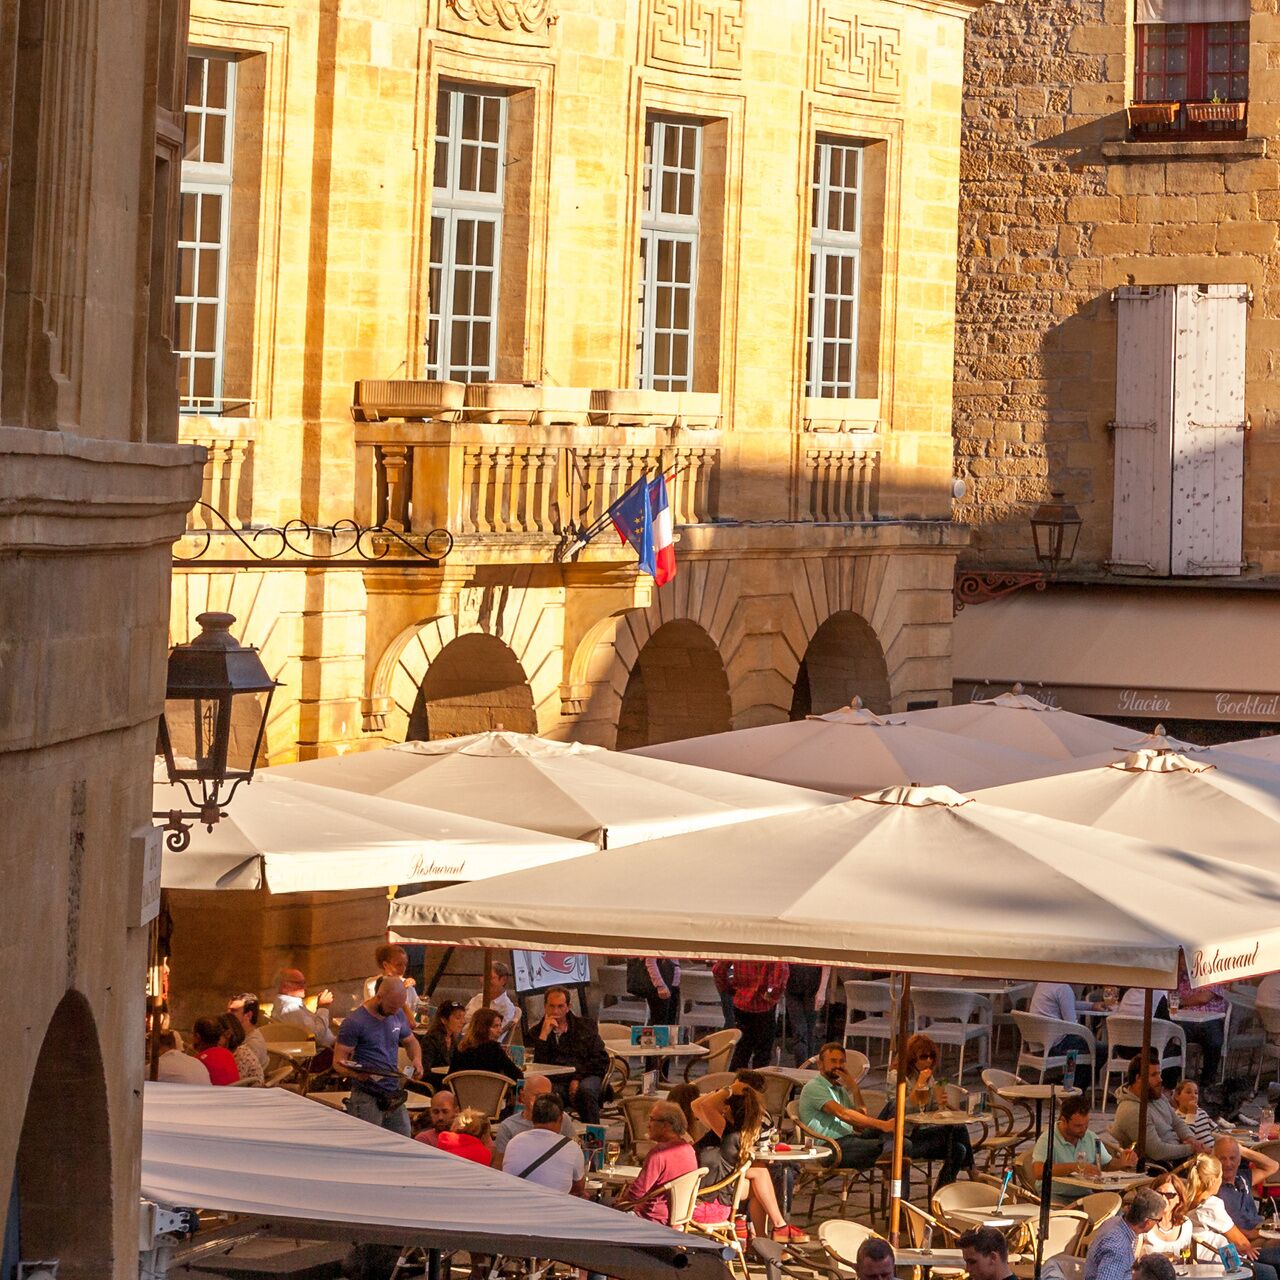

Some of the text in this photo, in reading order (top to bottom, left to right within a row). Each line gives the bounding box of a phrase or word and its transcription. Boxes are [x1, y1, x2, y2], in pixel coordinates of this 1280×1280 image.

[1117, 689, 1172, 712] Glacier
[1215, 692, 1280, 715] Cocktail
[406, 853, 466, 879] Restaurant
[1190, 941, 1259, 979] Restaurant
